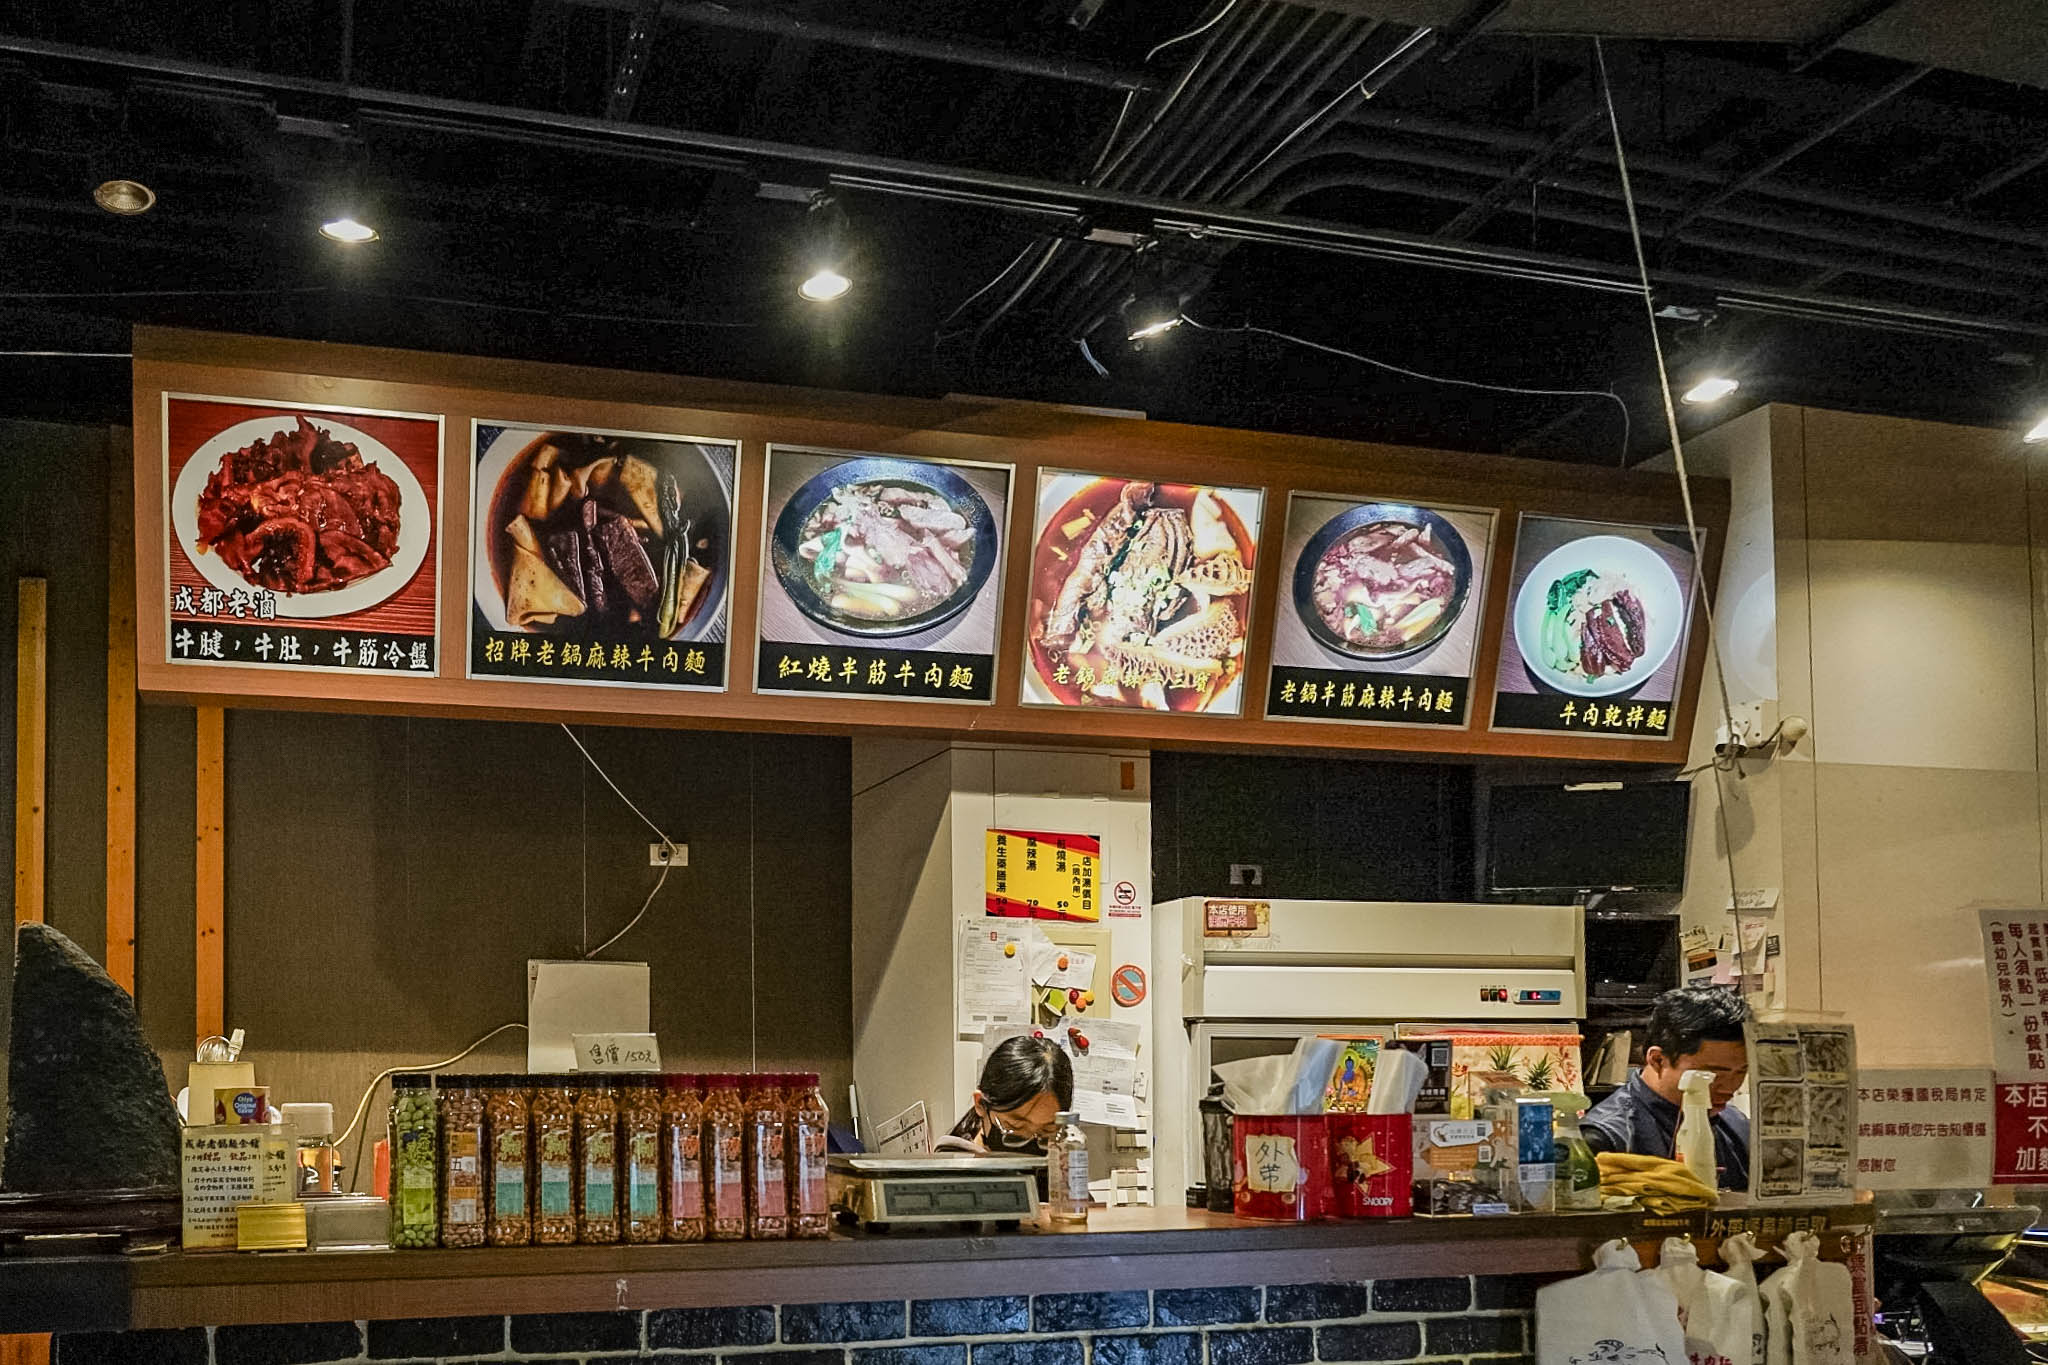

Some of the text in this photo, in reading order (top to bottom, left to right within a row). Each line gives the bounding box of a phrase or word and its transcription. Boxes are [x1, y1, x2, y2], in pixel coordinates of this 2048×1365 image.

[485, 636, 706, 675] 招牌老鍋麻辣牛肉麵
[779, 655, 974, 691] 紅燒半筋牛肉麵
[1280, 679, 1454, 713] 老鍋半筋麻辣牛肉麵
[1559, 701, 1668, 730] 牛肉乾拌麵
[2004, 1084, 2048, 1107] 本店
[1255, 1141, 1285, 1191] 外帶
